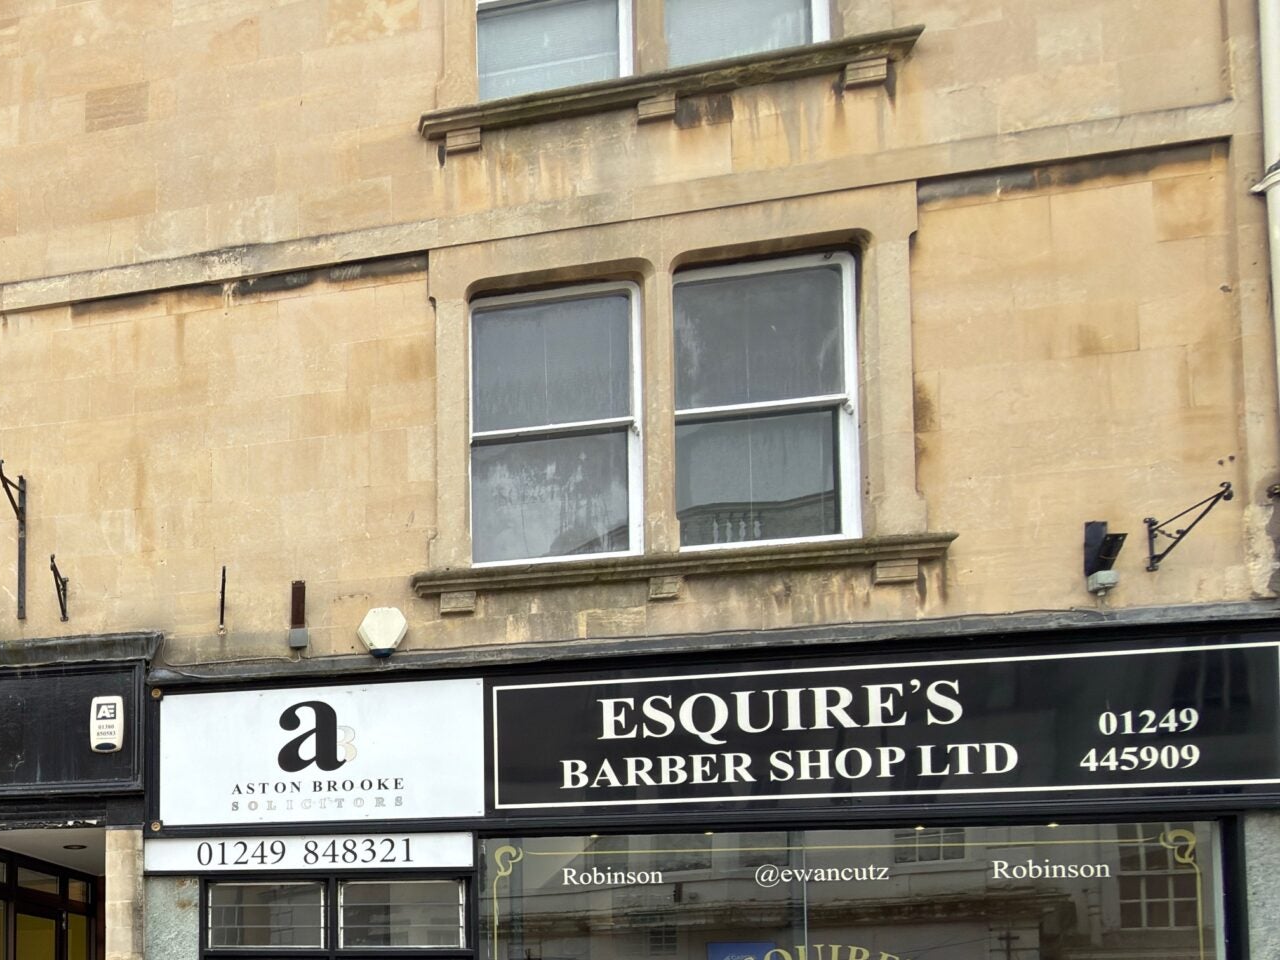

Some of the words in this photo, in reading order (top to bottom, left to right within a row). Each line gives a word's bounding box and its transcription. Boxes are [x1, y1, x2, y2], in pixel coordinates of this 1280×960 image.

[1098, 707, 1199, 736] 01249
[560, 752, 757, 789] BARBER
[769, 746, 907, 781] SHOP
[917, 741, 1018, 777] LTD
[1079, 744, 1200, 772] 445909
[232, 781, 302, 795] ASTON
[312, 778, 404, 793] BROOKE
[232, 796, 404, 812] SOLICITORS
[196, 840, 287, 867] 01249
[302, 838, 415, 865] 848321
[562, 867, 664, 886] Robinson
[755, 863, 890, 888] @ewancutz
[992, 859, 1110, 879] Robinson
